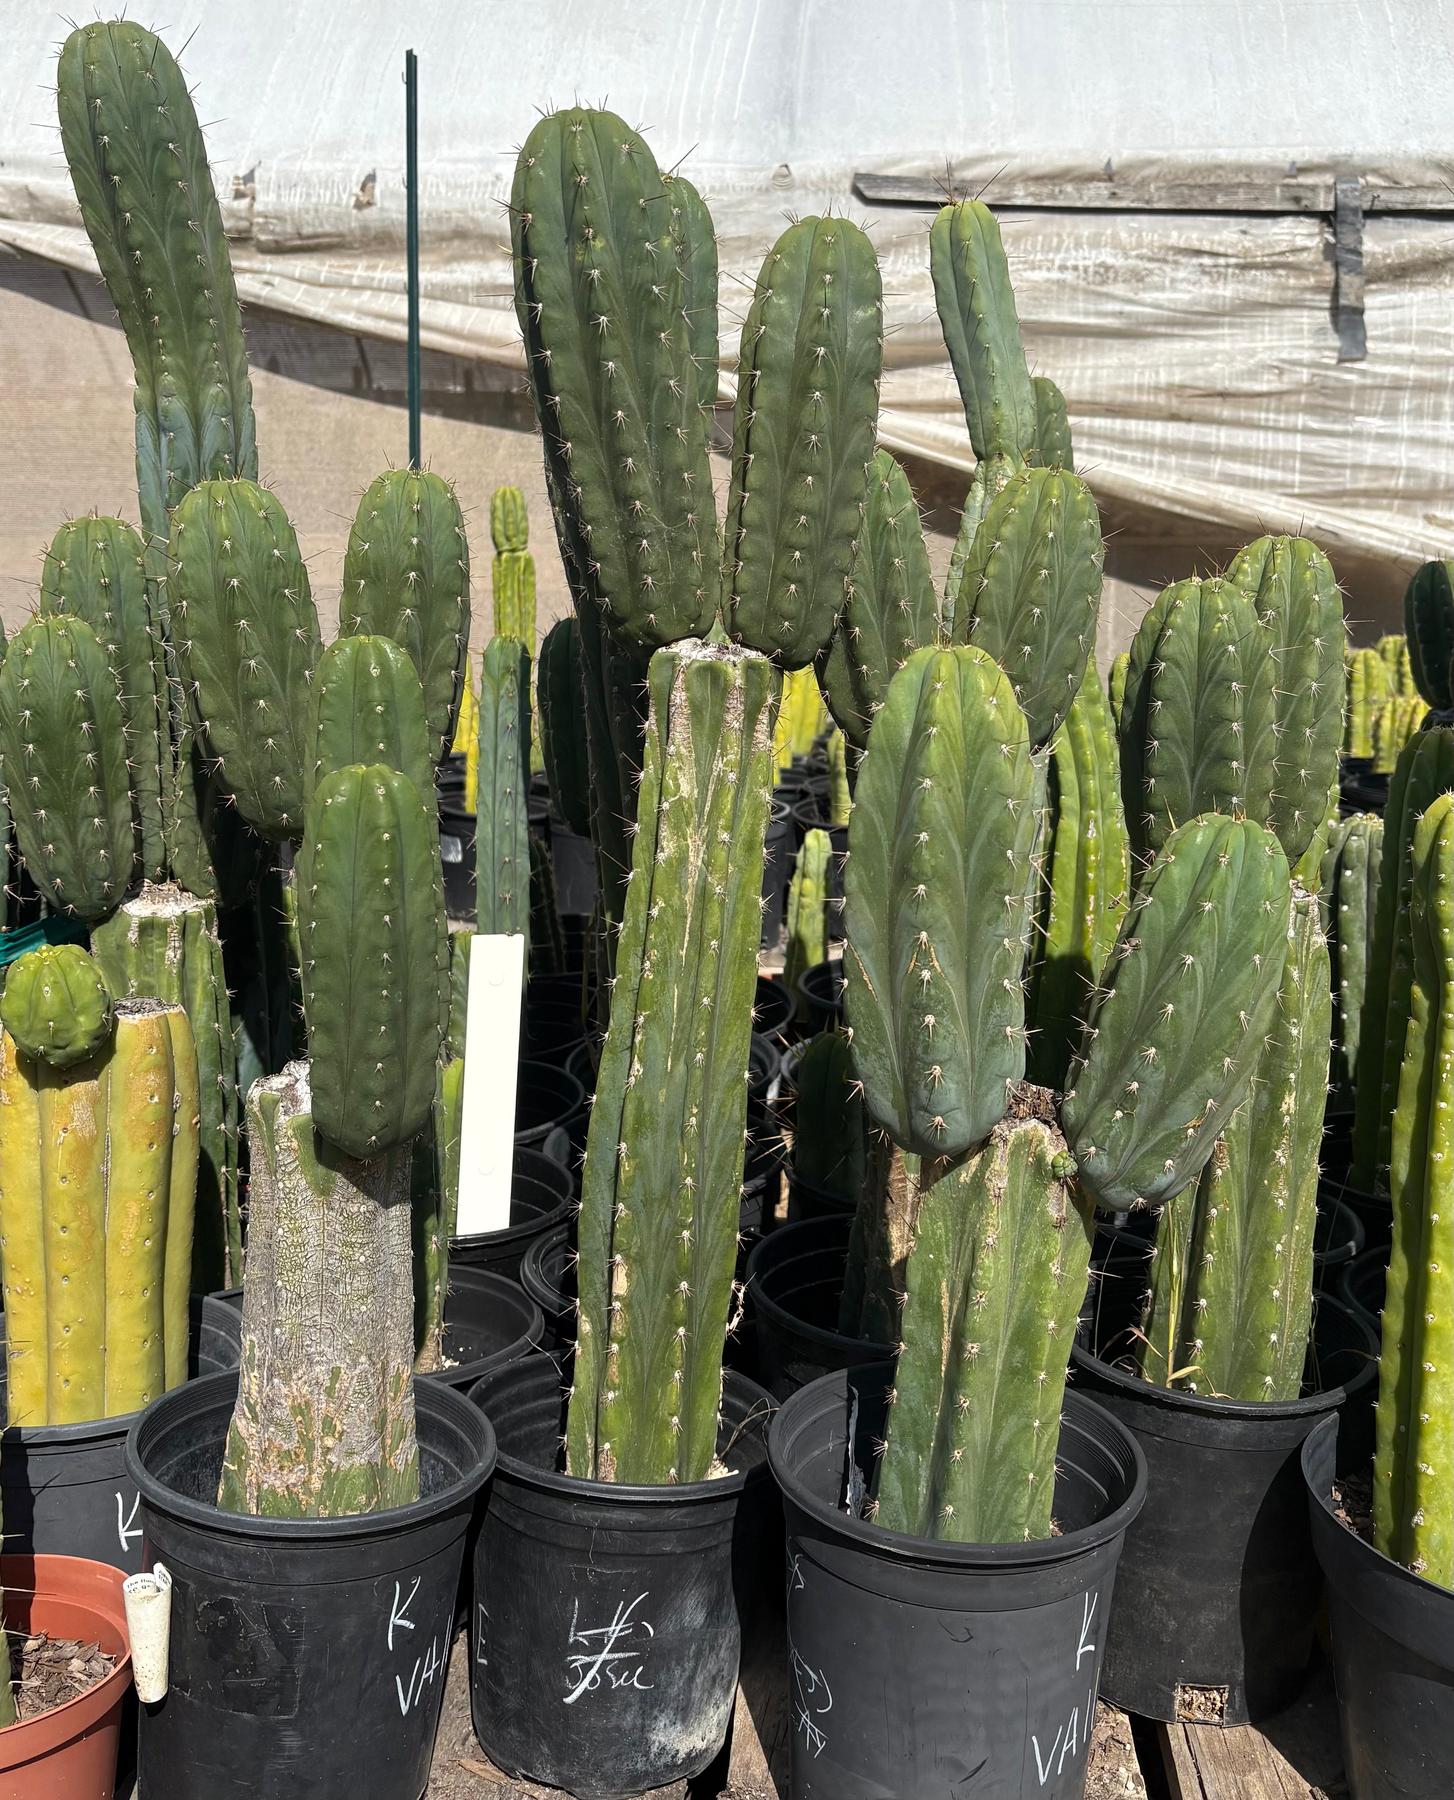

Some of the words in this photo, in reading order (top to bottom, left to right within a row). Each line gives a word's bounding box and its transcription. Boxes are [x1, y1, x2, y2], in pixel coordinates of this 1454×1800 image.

[115, 1491, 144, 1552] K
[388, 1575, 421, 1651] K
[1076, 1592, 1098, 1671] K
